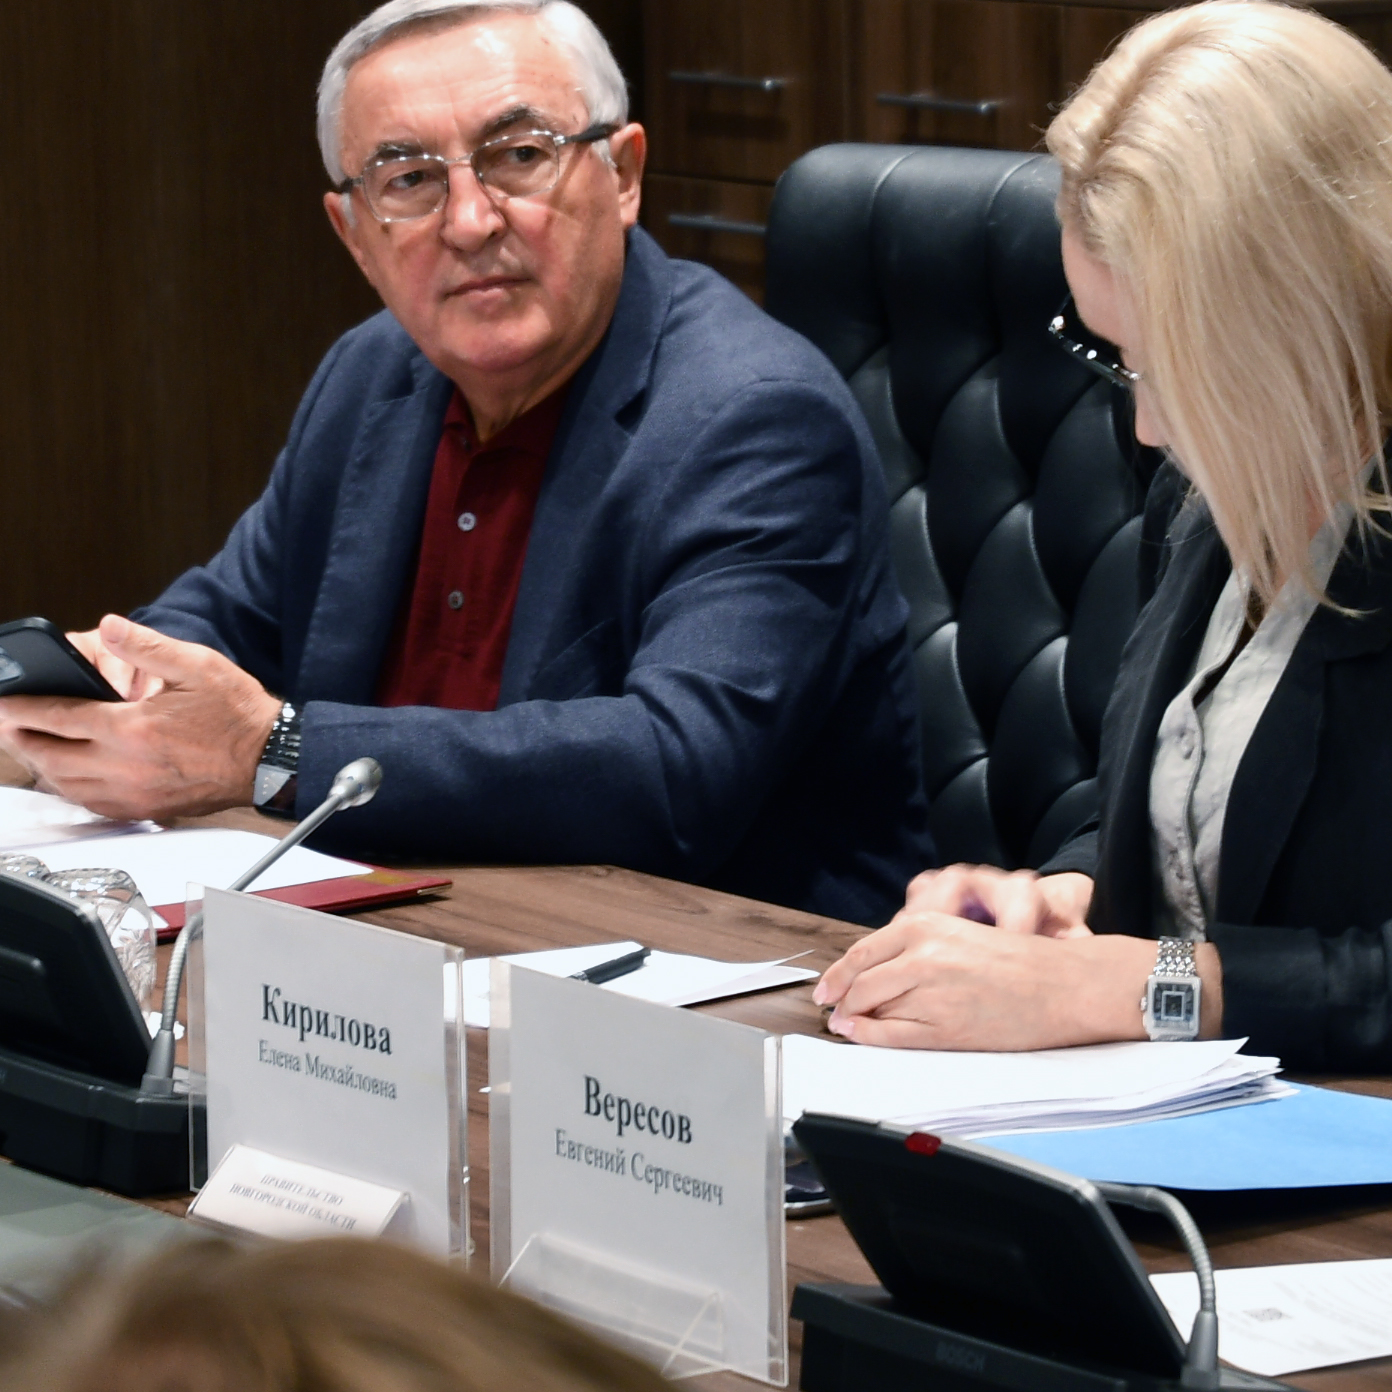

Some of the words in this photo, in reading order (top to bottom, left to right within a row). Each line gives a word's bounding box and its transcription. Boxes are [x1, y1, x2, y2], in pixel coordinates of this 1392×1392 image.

[261, 983, 393, 1055] Кирилова
[258, 1039, 303, 1072] Елена
[305, 1054, 398, 1101] Михайловна
[583, 1074, 693, 1145] Вересов
[554, 1127, 627, 1177] Евгений
[630, 1151, 725, 1206] Сергеевич
